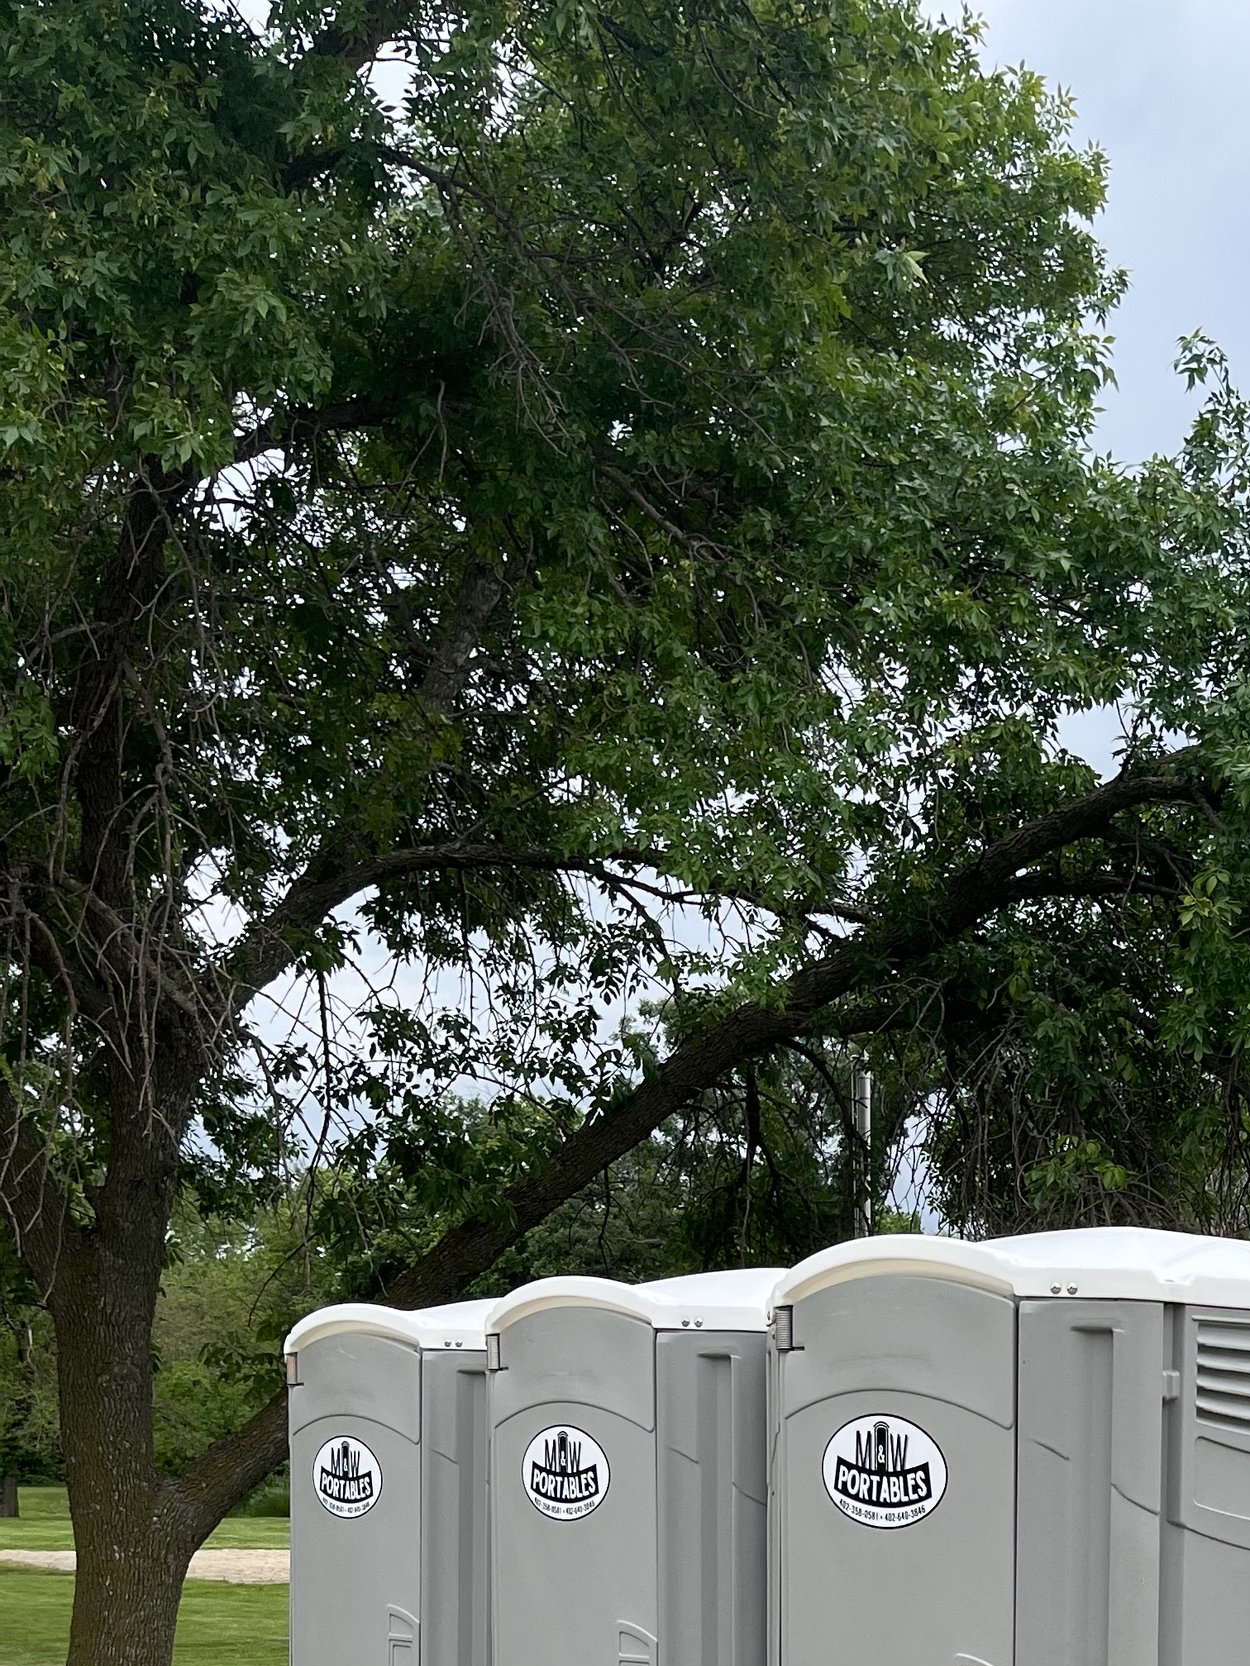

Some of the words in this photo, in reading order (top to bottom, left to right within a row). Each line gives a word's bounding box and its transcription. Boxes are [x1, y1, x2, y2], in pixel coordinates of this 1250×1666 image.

[320, 1471, 372, 1500] PORTABLES
[532, 1467, 596, 1500] PORTABLES
[837, 1464, 928, 1504] PORTABLES
[840, 1498, 879, 1521] 402-358-0581
[884, 1504, 926, 1522] 402-640-3846
